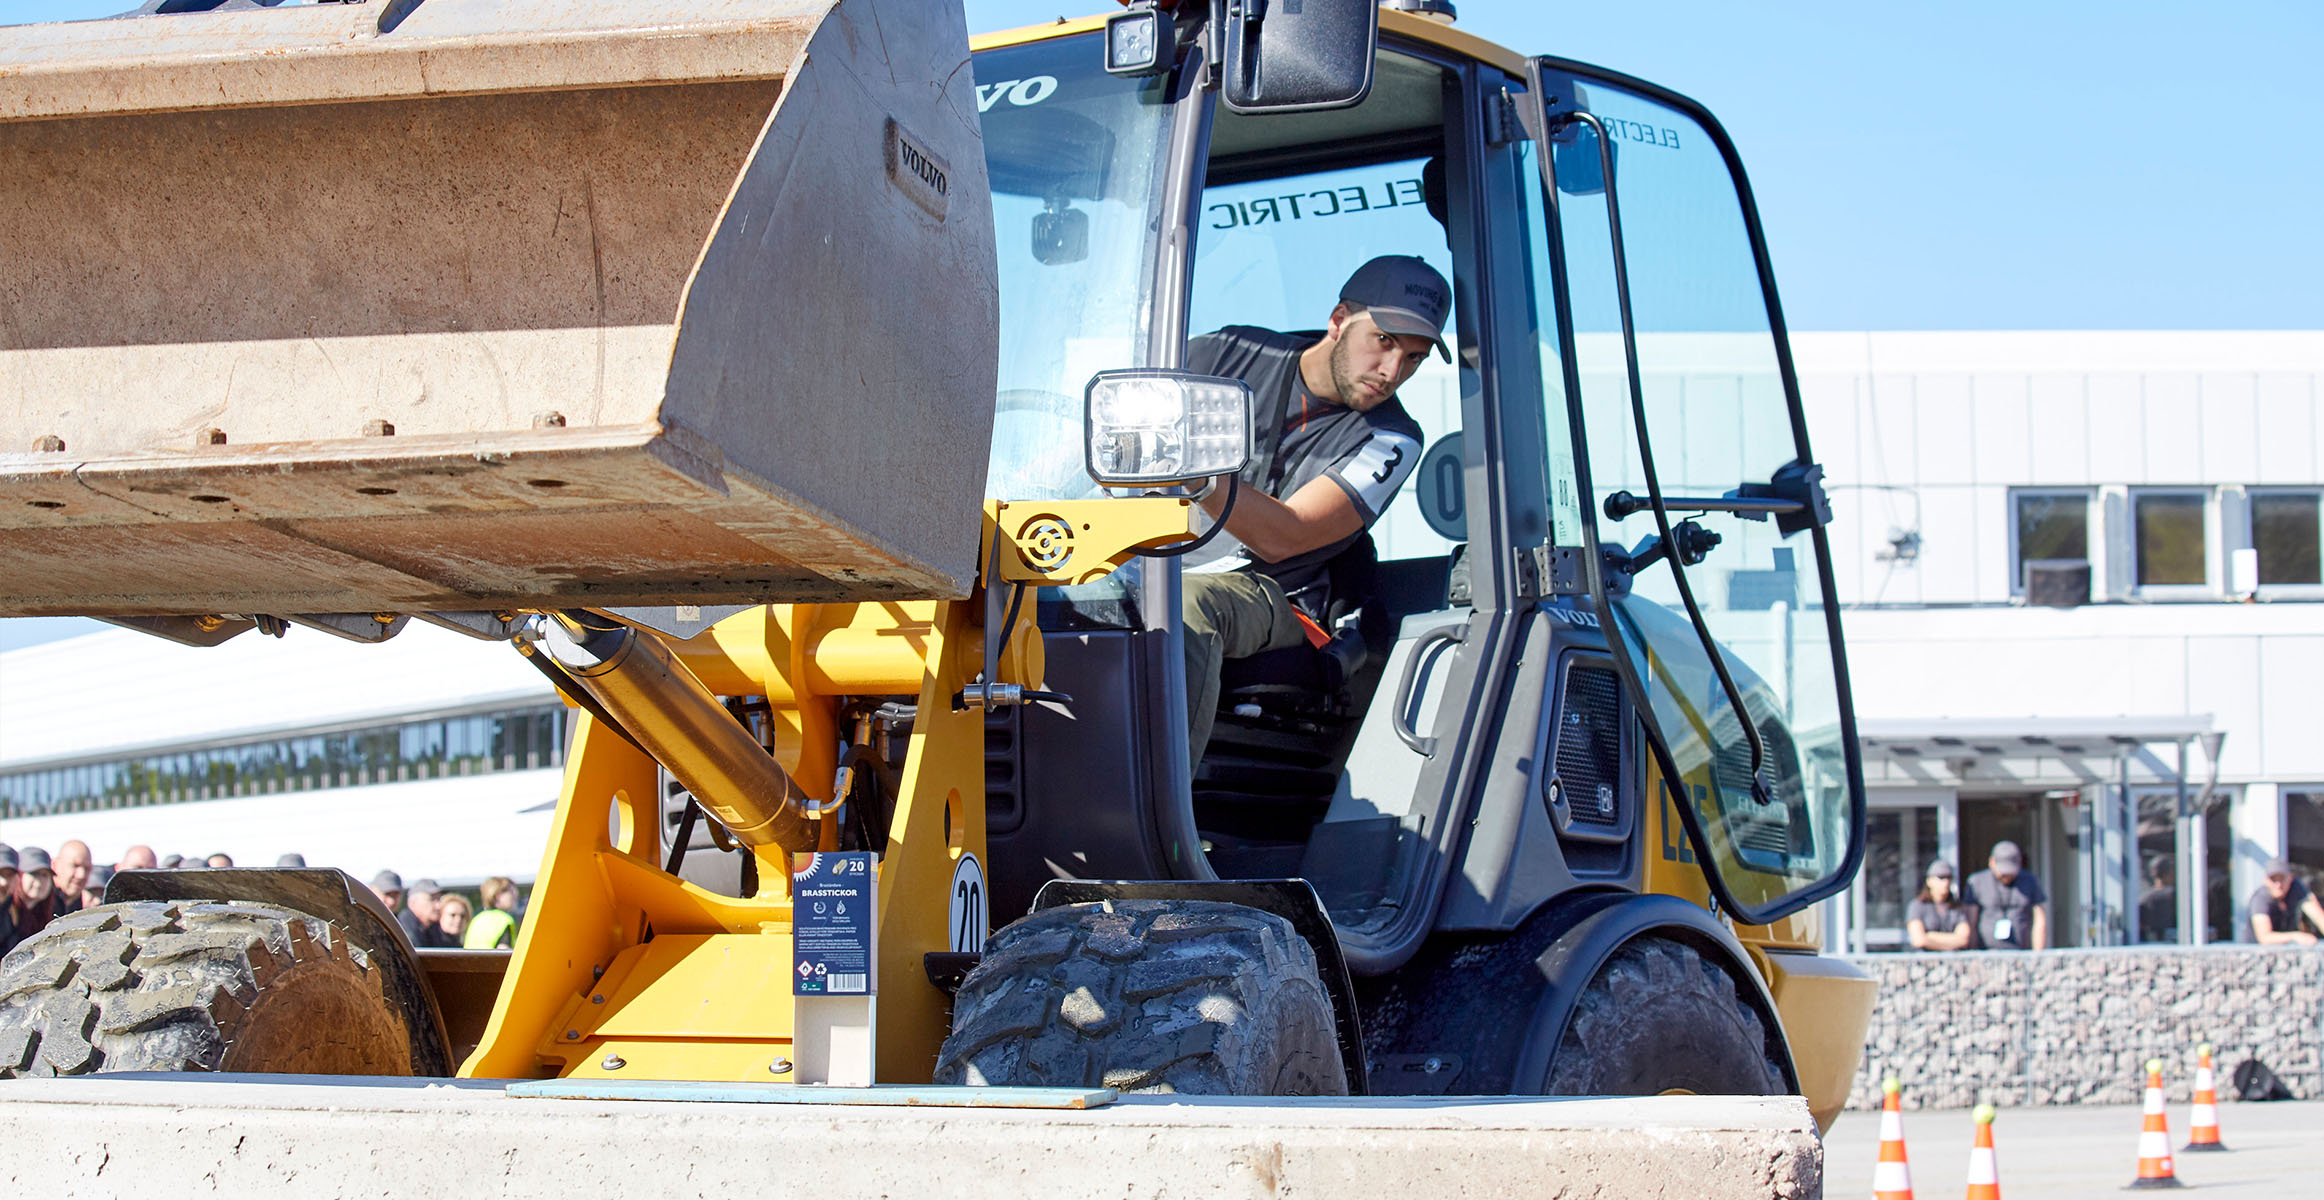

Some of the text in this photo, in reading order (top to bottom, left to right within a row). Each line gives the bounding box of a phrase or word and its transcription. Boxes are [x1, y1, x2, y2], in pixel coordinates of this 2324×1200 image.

[900, 138, 947, 197] VOLVO
[1372, 445, 1403, 484] 3
[849, 861, 865, 872] 20
[801, 889, 858, 897] BRASSTICKOR
[958, 880, 980, 953] 20
